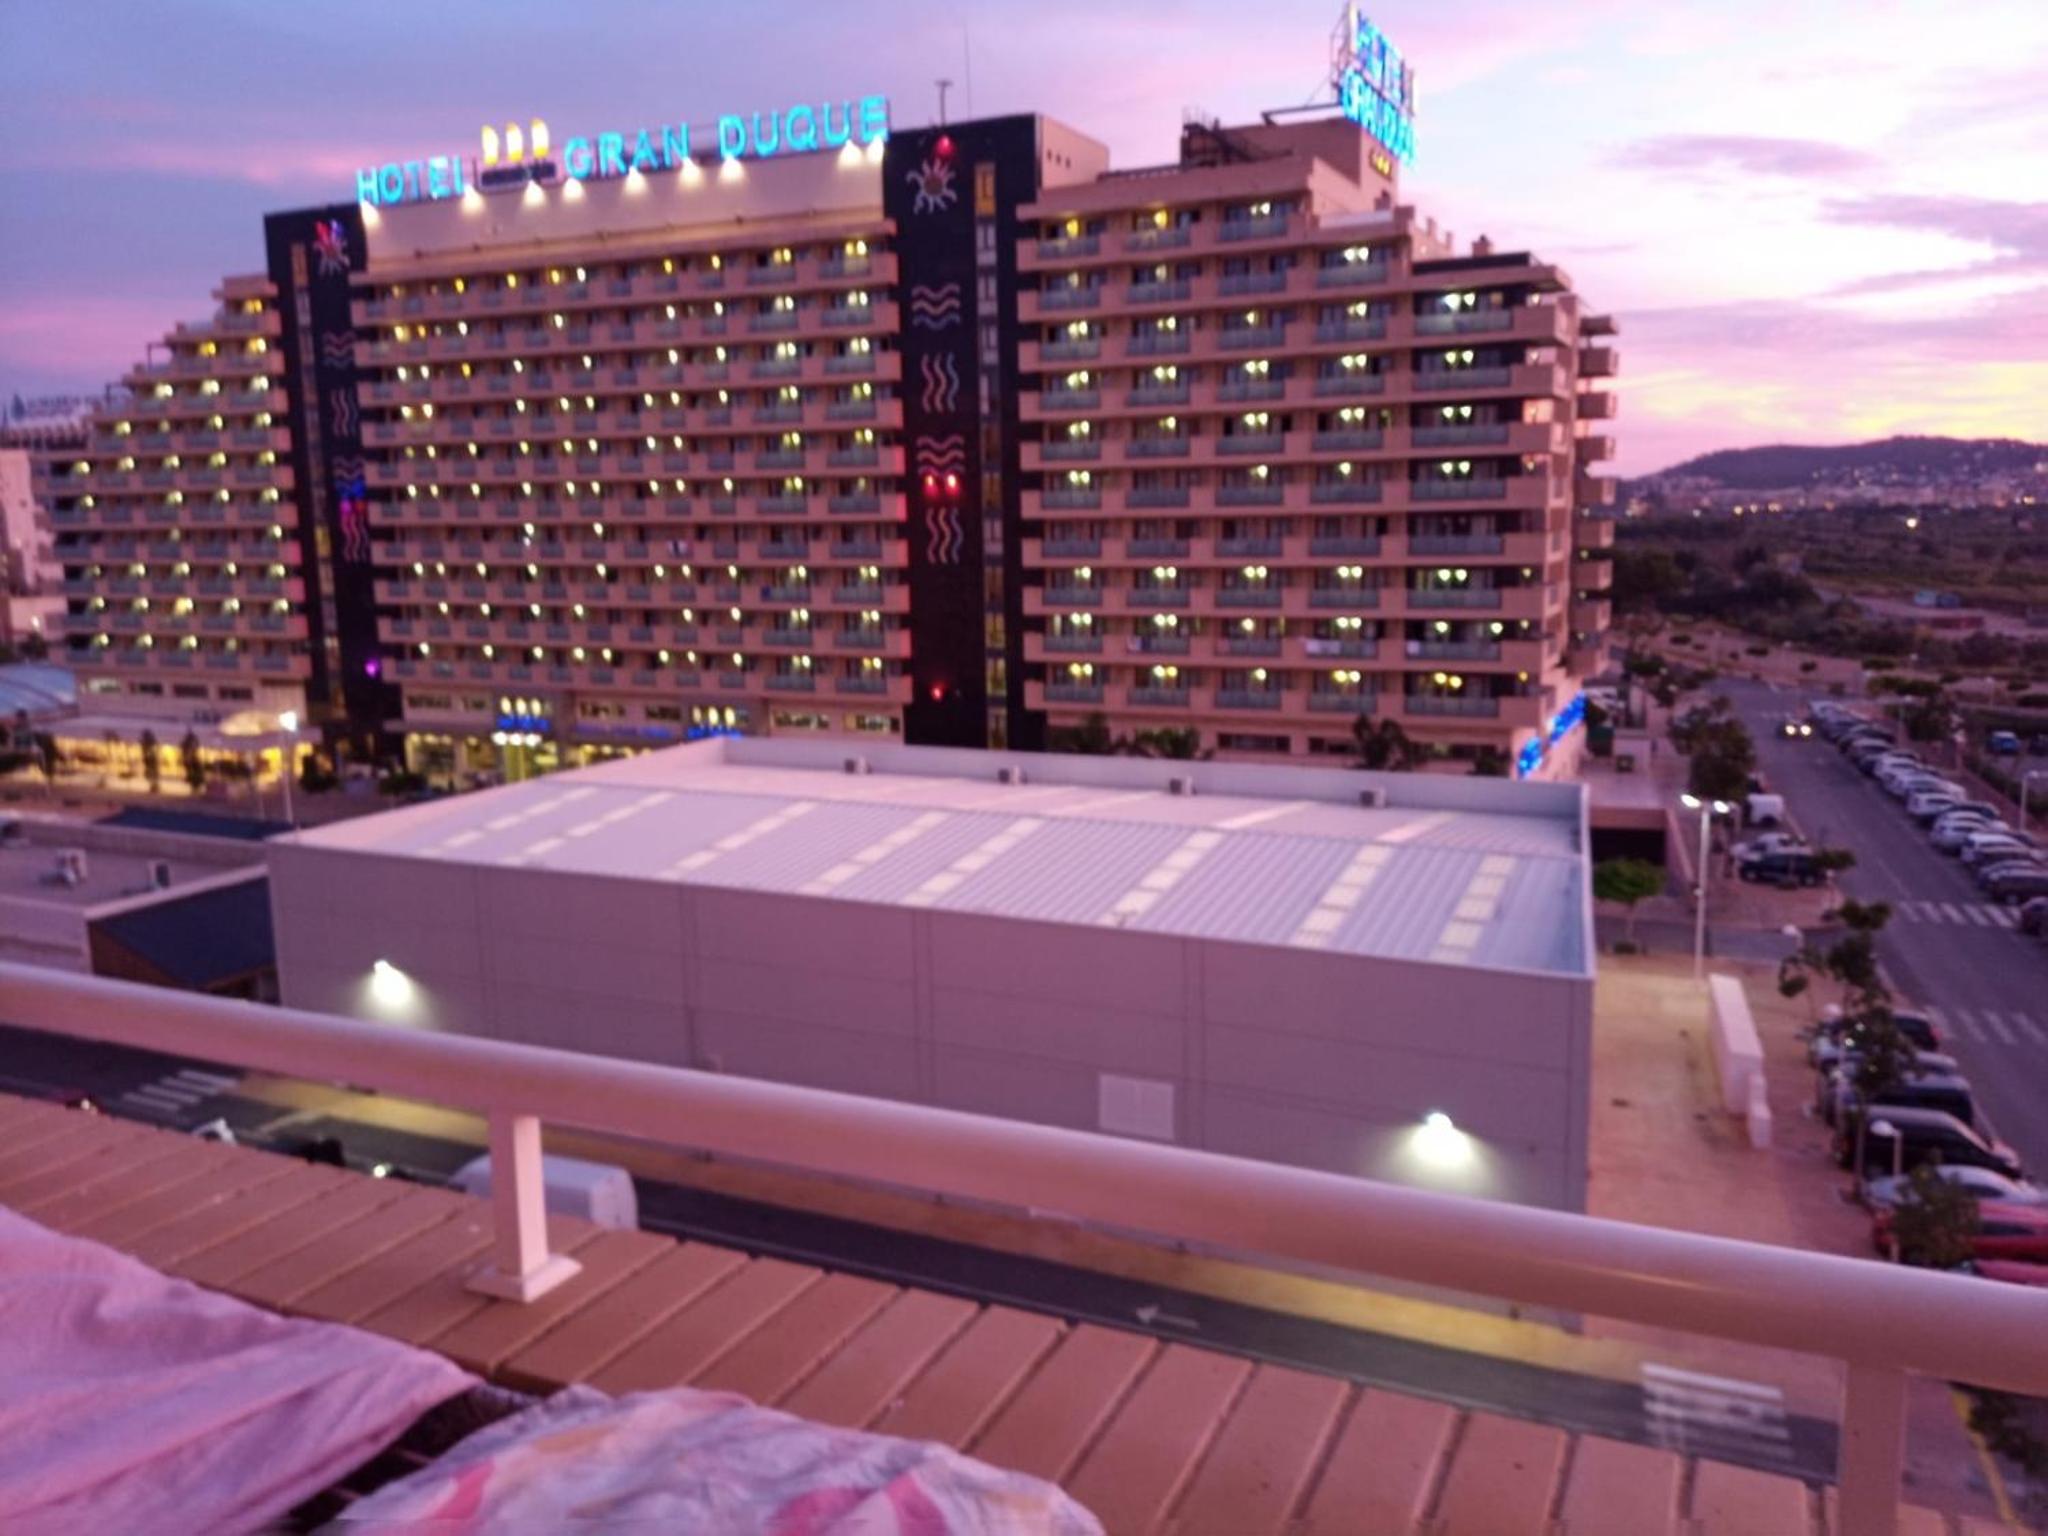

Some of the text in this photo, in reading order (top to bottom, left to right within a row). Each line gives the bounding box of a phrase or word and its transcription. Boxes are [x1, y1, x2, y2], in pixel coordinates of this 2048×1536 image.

[356, 94, 889, 206] HOTEL GRAN DUQUE
